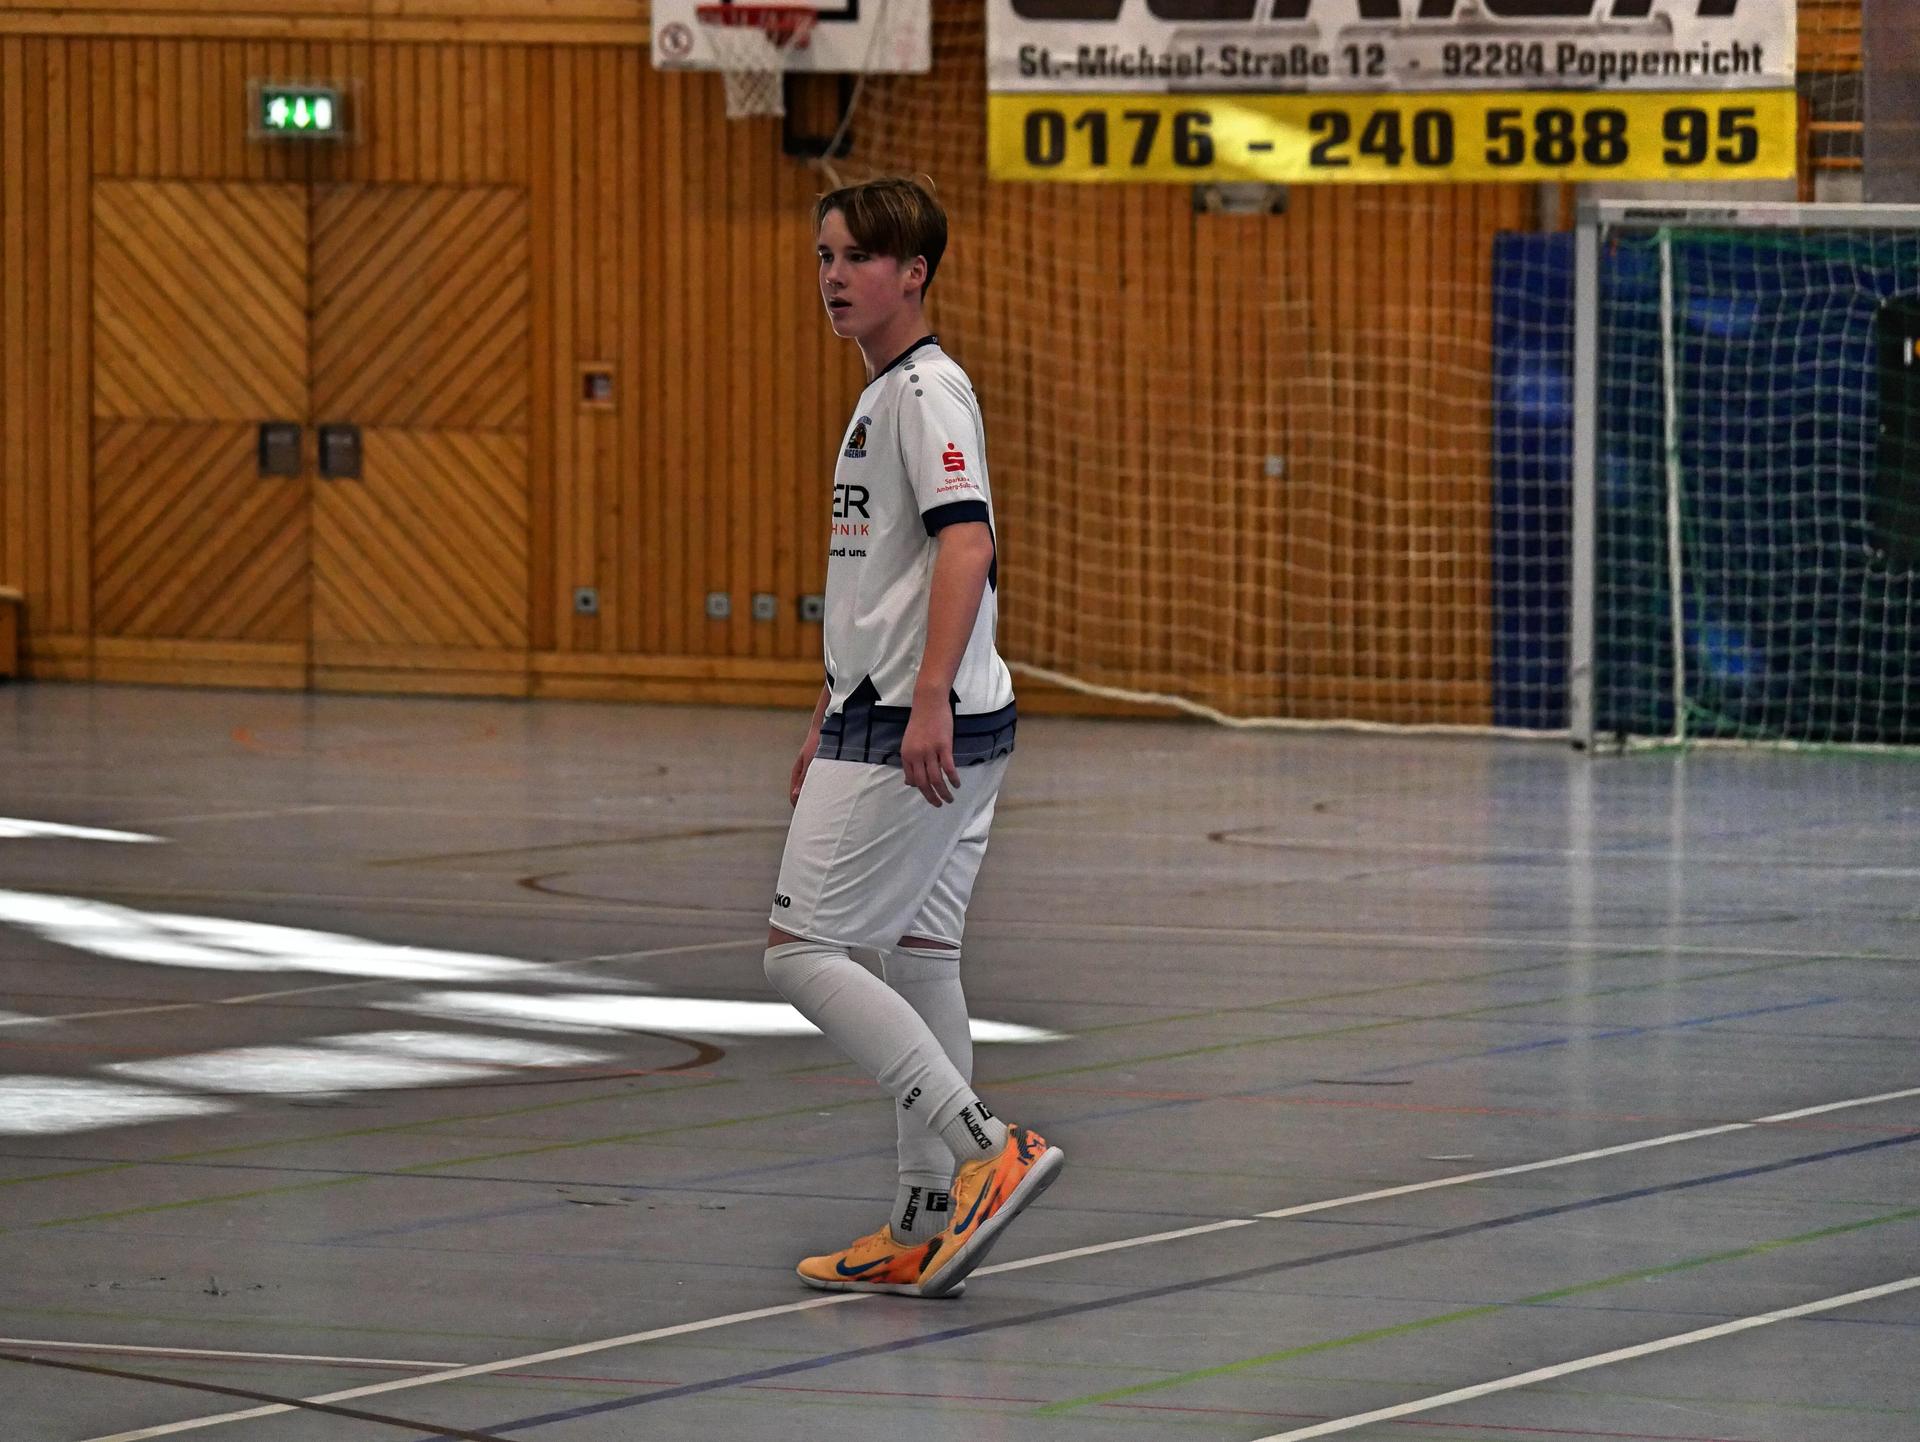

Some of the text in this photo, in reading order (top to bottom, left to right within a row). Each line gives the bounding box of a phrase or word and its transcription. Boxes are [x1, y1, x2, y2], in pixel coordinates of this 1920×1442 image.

[1018, 40, 1764, 82] St.-Michael-Straße 12 92284 Poppenricht
[1024, 108, 1214, 167] 0176
[1308, 108, 1454, 167] 240
[1485, 106, 1630, 167] 588
[1662, 106, 1759, 167] 95
[848, 548, 867, 558] uns
